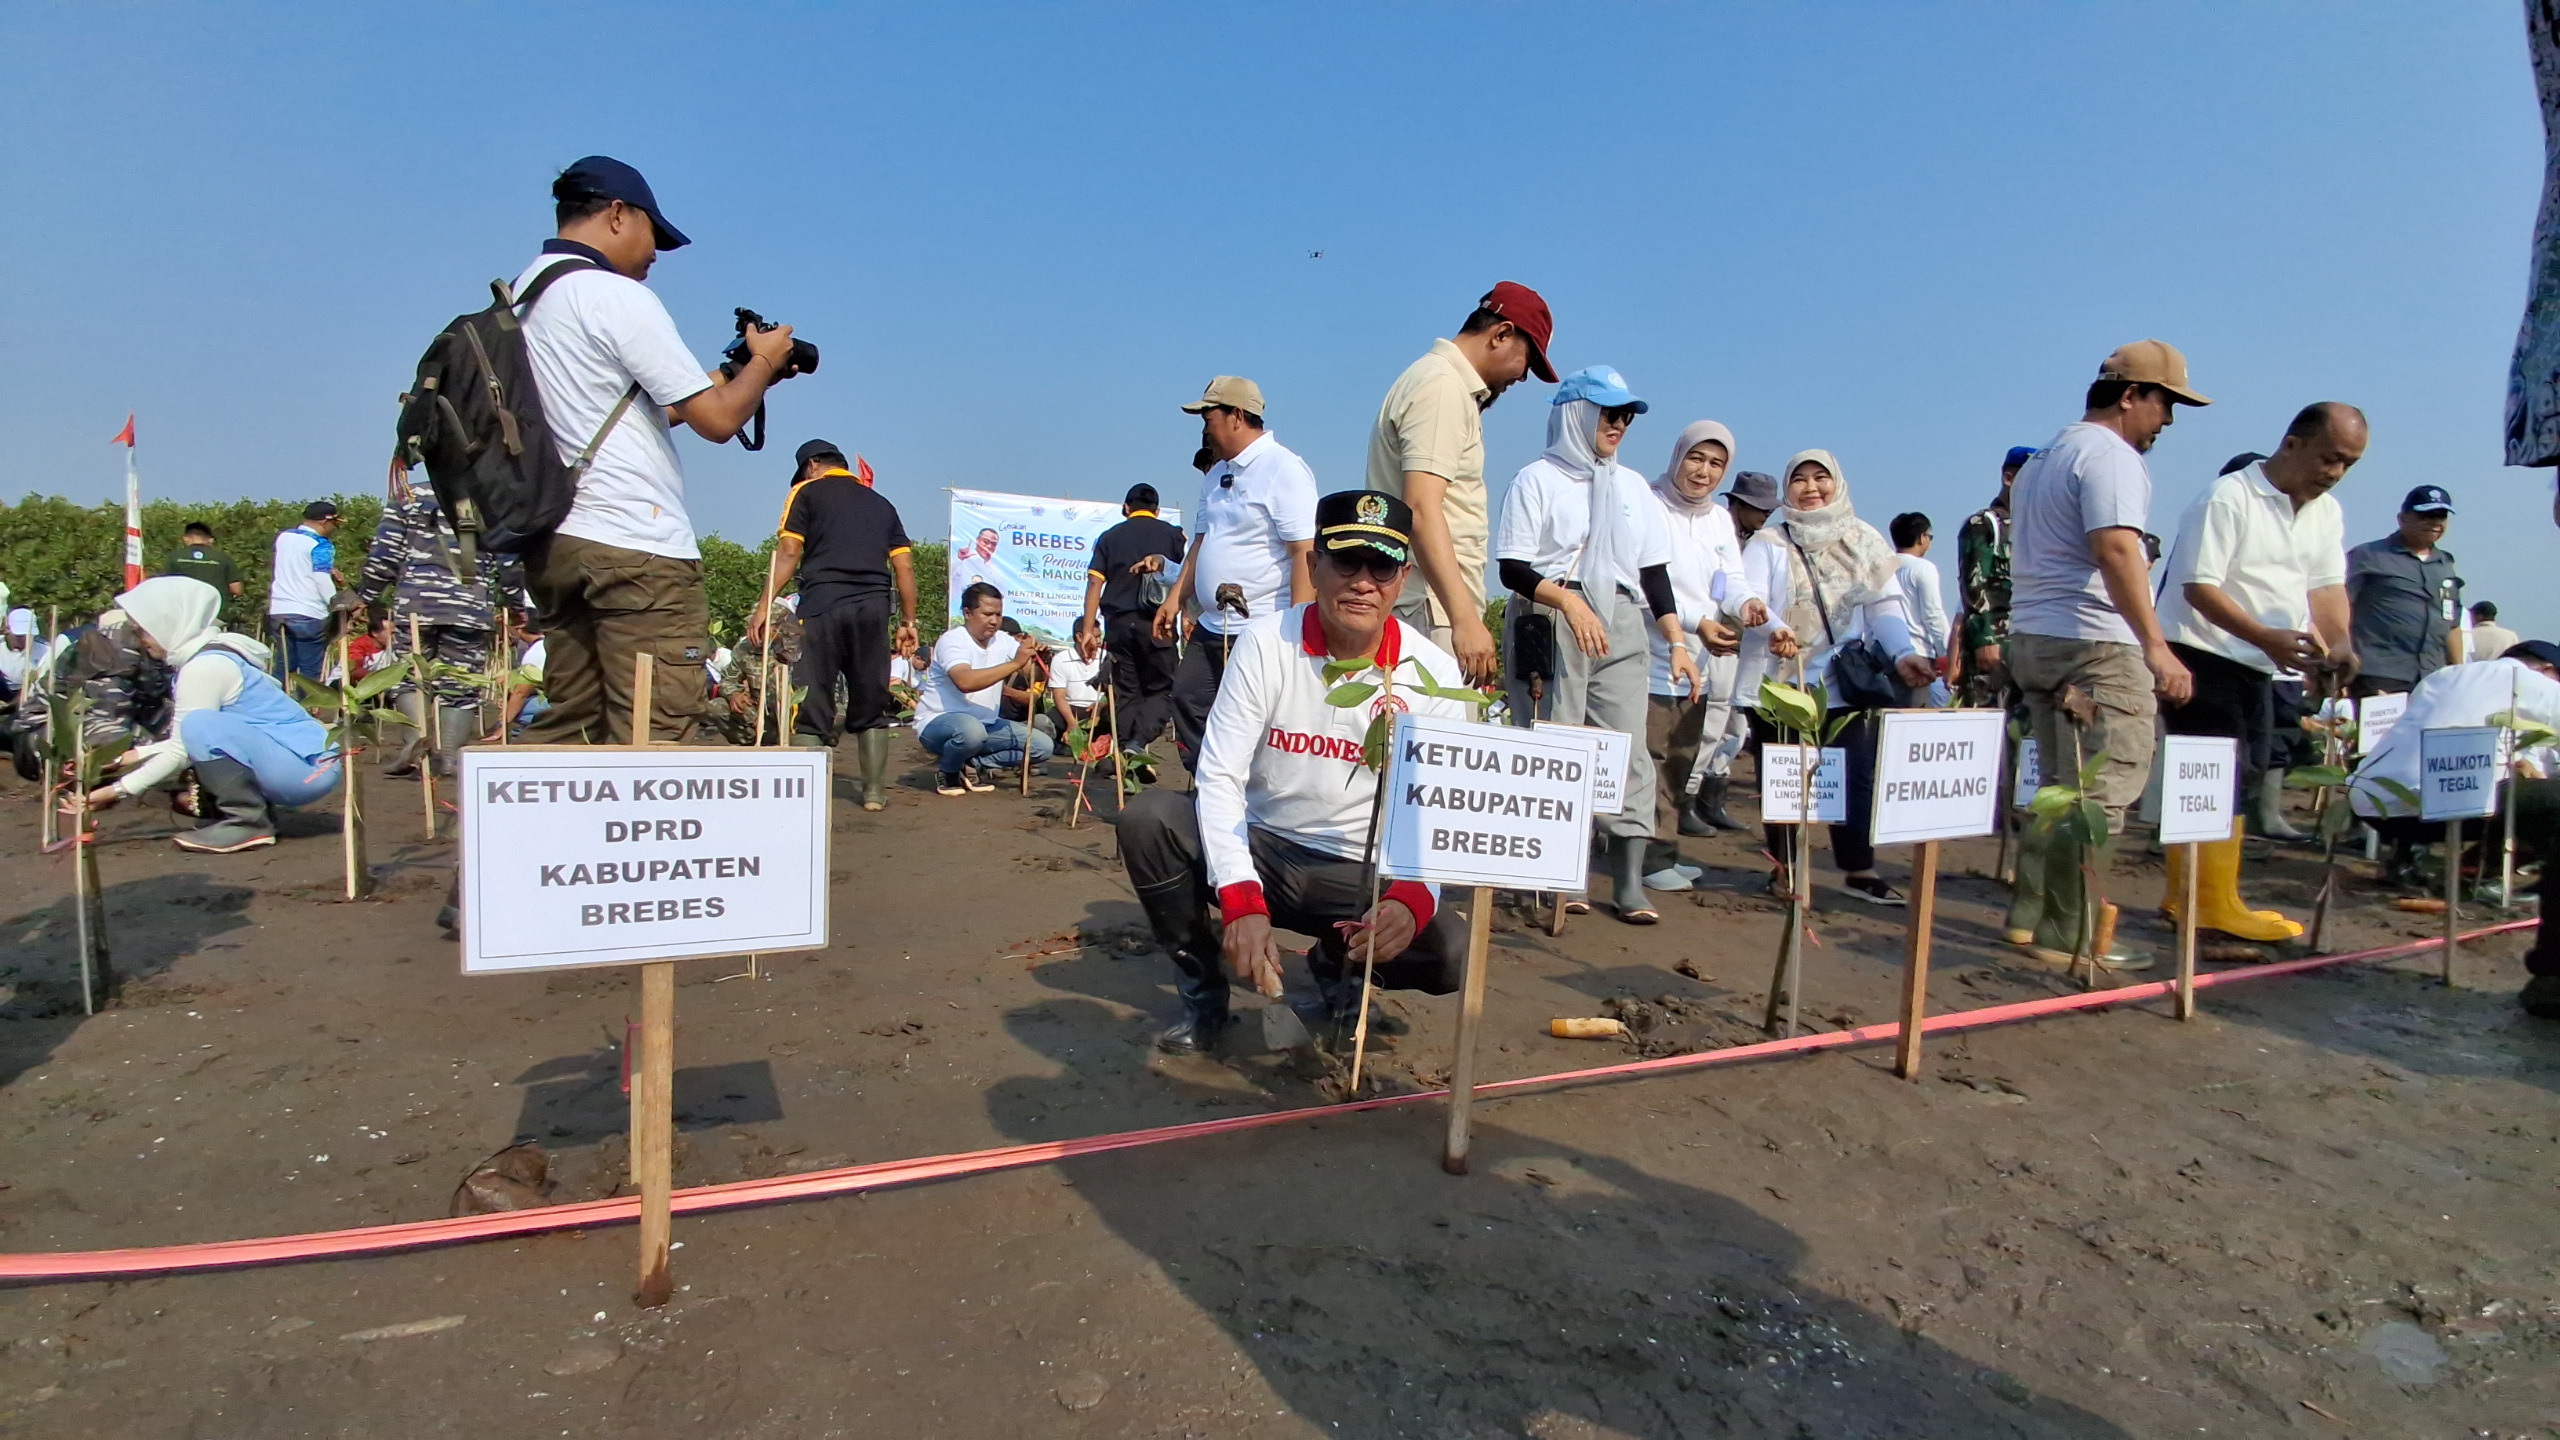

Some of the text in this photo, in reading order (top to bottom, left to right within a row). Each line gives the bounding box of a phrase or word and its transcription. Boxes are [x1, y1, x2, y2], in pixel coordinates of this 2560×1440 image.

[1012, 531, 1085, 551] BREBES
[1042, 553, 1090, 569] Penana
[1046, 593, 1084, 601] LINGKUN
[1405, 740, 1582, 783] KETUA DPRD
[1771, 756, 1803, 766] KEPAL
[1908, 741, 1974, 763] BUPATI
[2179, 762, 2221, 780] BUPATI
[2427, 754, 2491, 773] WALIKOTA
[487, 778, 806, 804] KETUA KOMISI III
[1769, 779, 1839, 789] PENGEALIAN
[1885, 777, 1987, 802] PEMALANG
[2438, 776, 2480, 793] TEGAL
[1405, 783, 1573, 822] KABUPATEN
[1775, 790, 1835, 800] LINGKNGAN
[2179, 795, 2217, 813] TEGAL
[605, 819, 703, 843] DPRD
[1431, 828, 1542, 860] BREBES
[540, 856, 760, 888] KABUPATEN
[581, 897, 725, 927] BREBES
